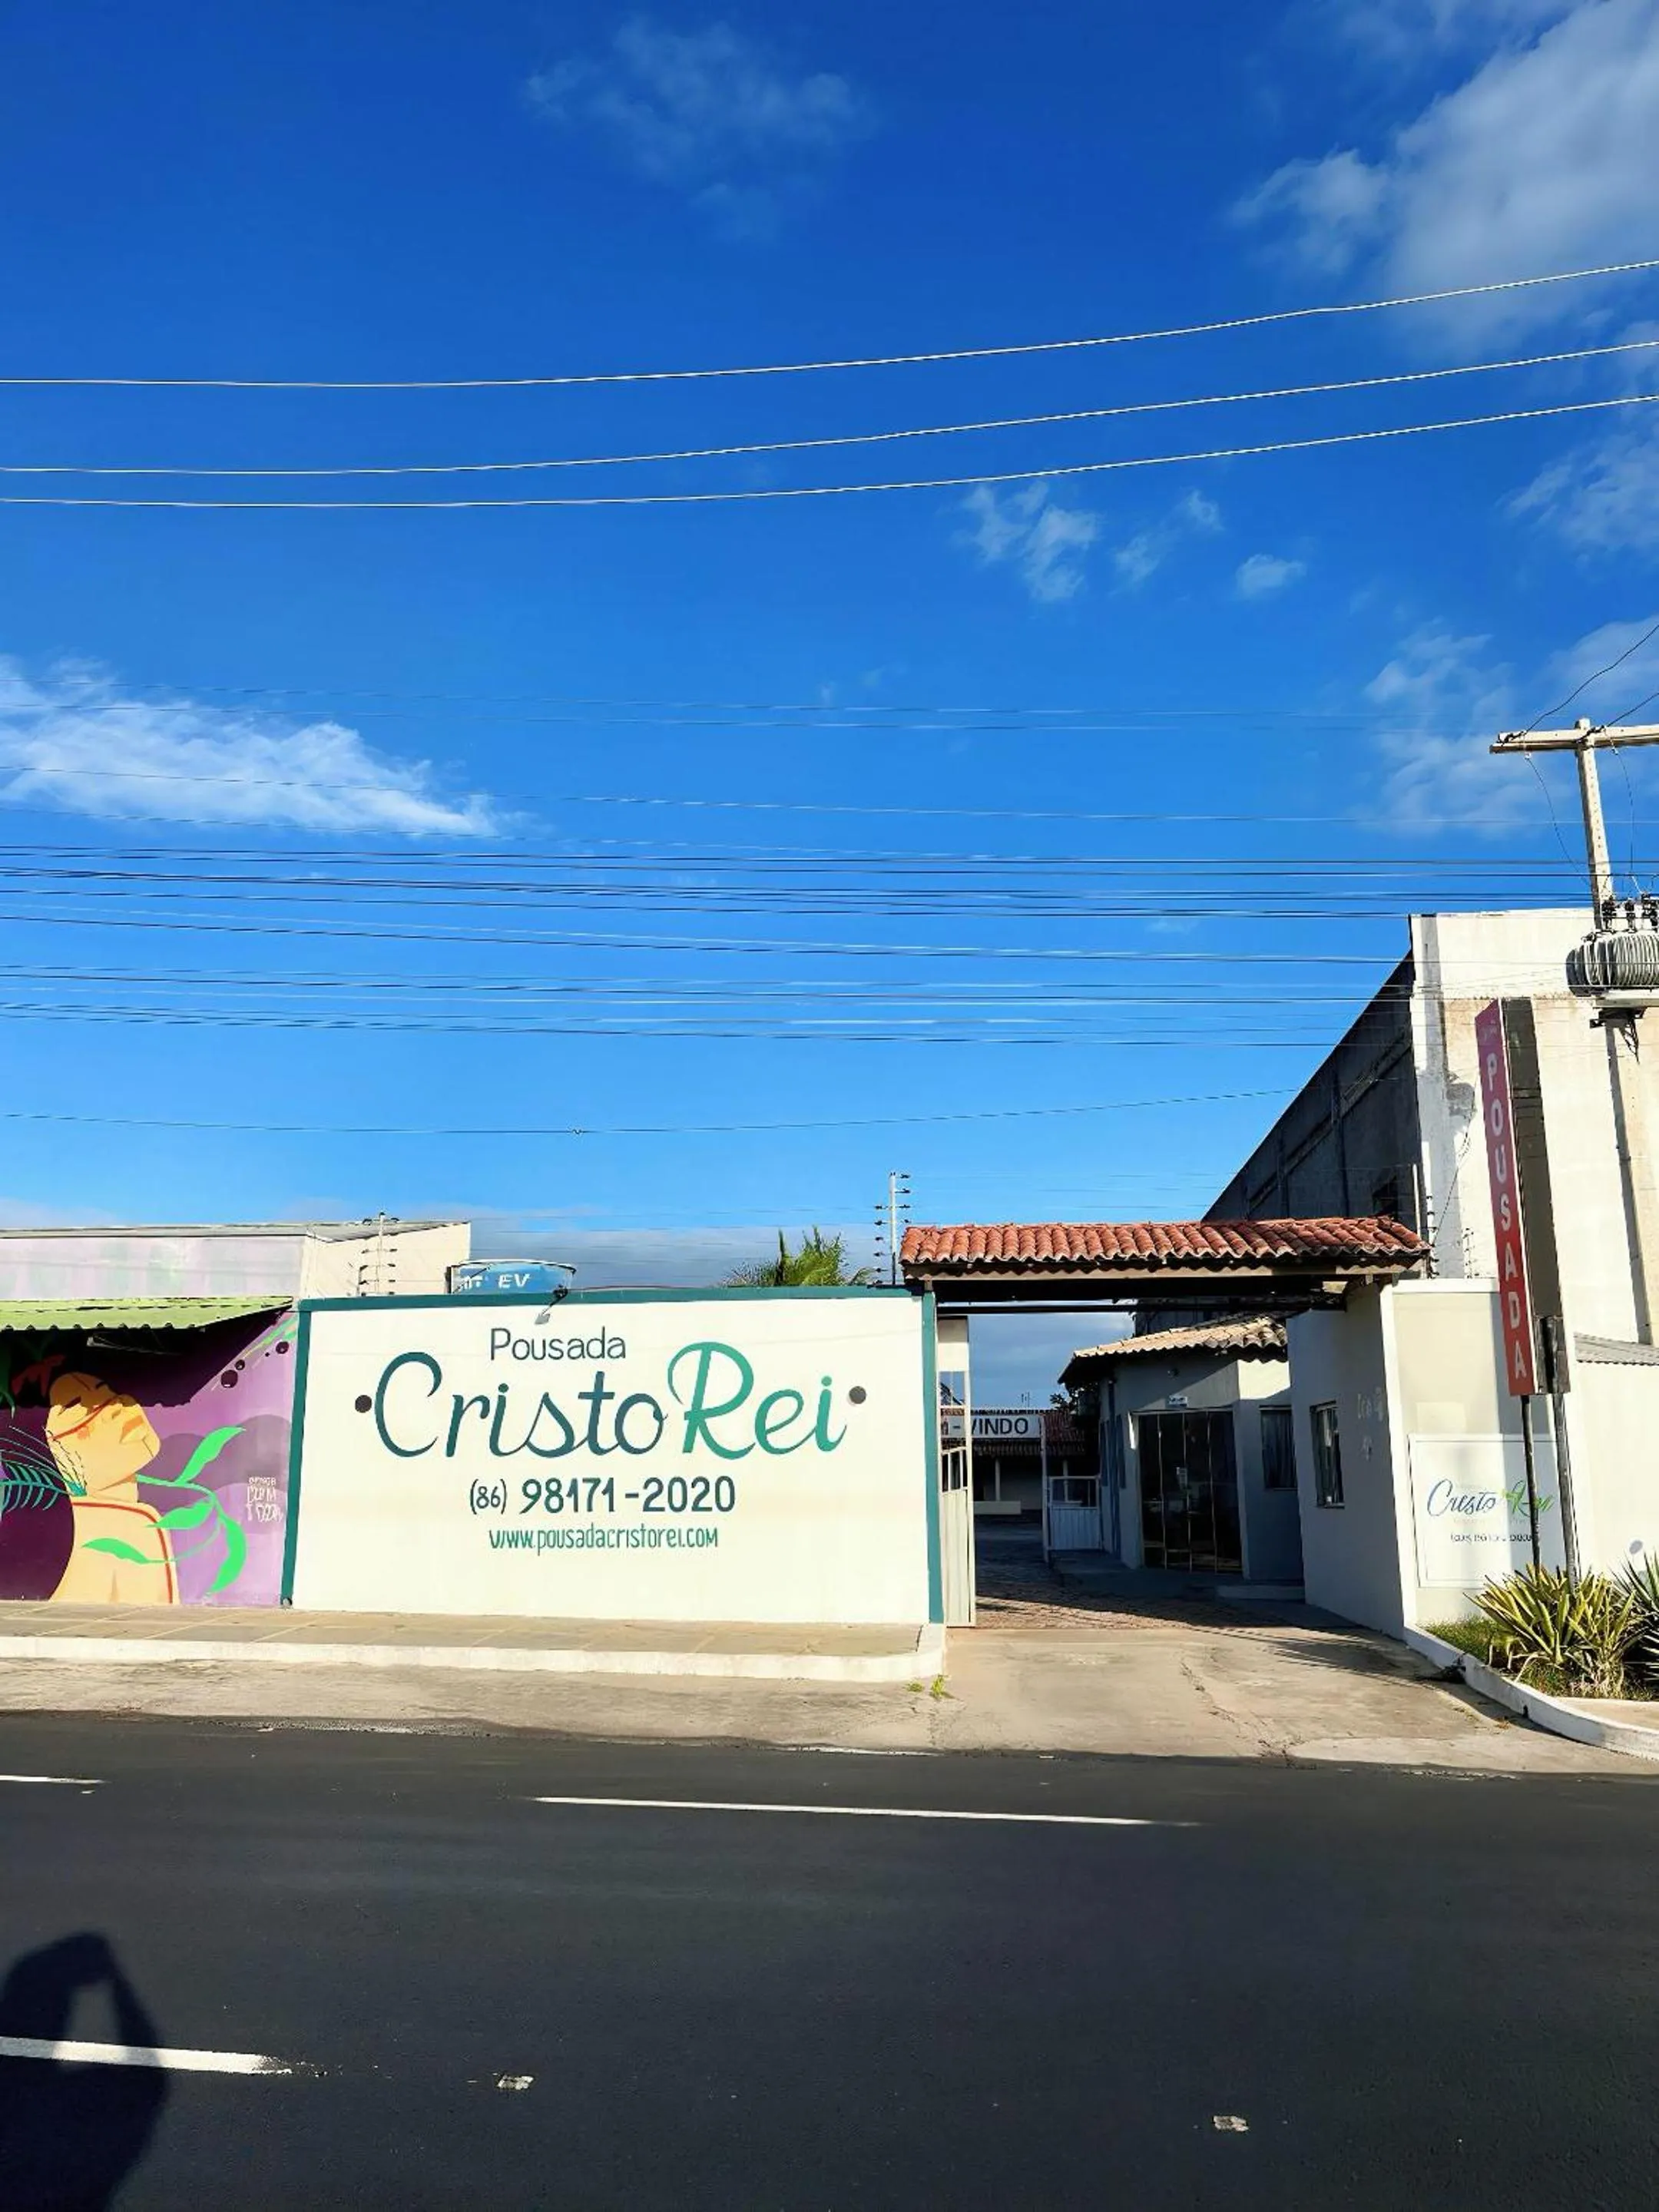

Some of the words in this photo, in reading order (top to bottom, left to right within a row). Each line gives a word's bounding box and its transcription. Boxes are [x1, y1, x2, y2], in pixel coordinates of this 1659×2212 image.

[1485, 1052, 1527, 1379] POUSADA
[490, 1327, 627, 1361] Pousada
[373, 1352, 668, 1458] Cristo
[667, 1341, 847, 1459] Rei
[469, 1479, 508, 1515] (86)
